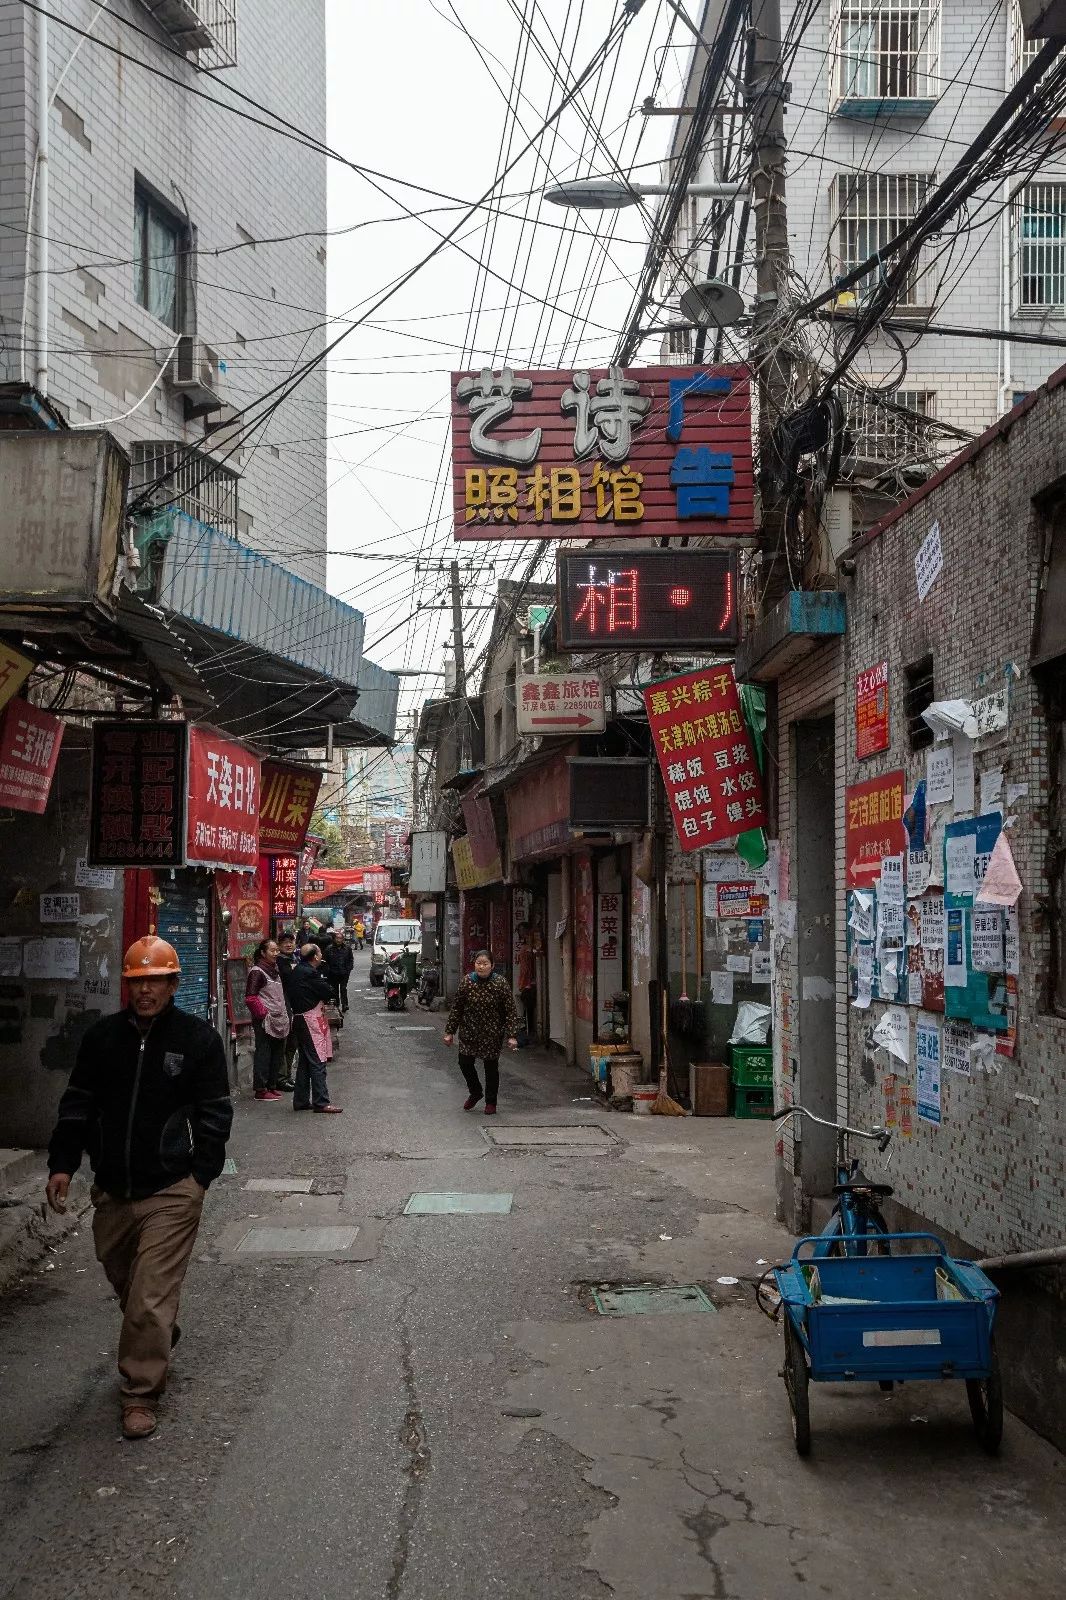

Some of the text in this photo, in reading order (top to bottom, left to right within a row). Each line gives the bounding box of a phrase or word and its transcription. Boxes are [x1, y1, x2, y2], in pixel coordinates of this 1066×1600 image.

[456, 367, 652, 464] 艺诗
[665, 371, 735, 518] 广告
[464, 462, 646, 522] 照相馆
[522, 680, 600, 702] 鑫鑫旅馆
[650, 673, 732, 716] 嘉兴粽子
[658, 708, 743, 755] 天津狗不理汤包
[207, 751, 256, 815] 天姿日化
[667, 743, 750, 785] 稀饭 豆浆
[260, 772, 315, 828] 川菜
[675, 770, 757, 812] 馄饨 水饺
[681, 797, 763, 838] 包子 馒头
[274, 869, 297, 883] 川菜
[275, 858, 297, 868] 九寨沟
[274, 884, 297, 898] 火锅
[274, 900, 297, 914] 夜宵
